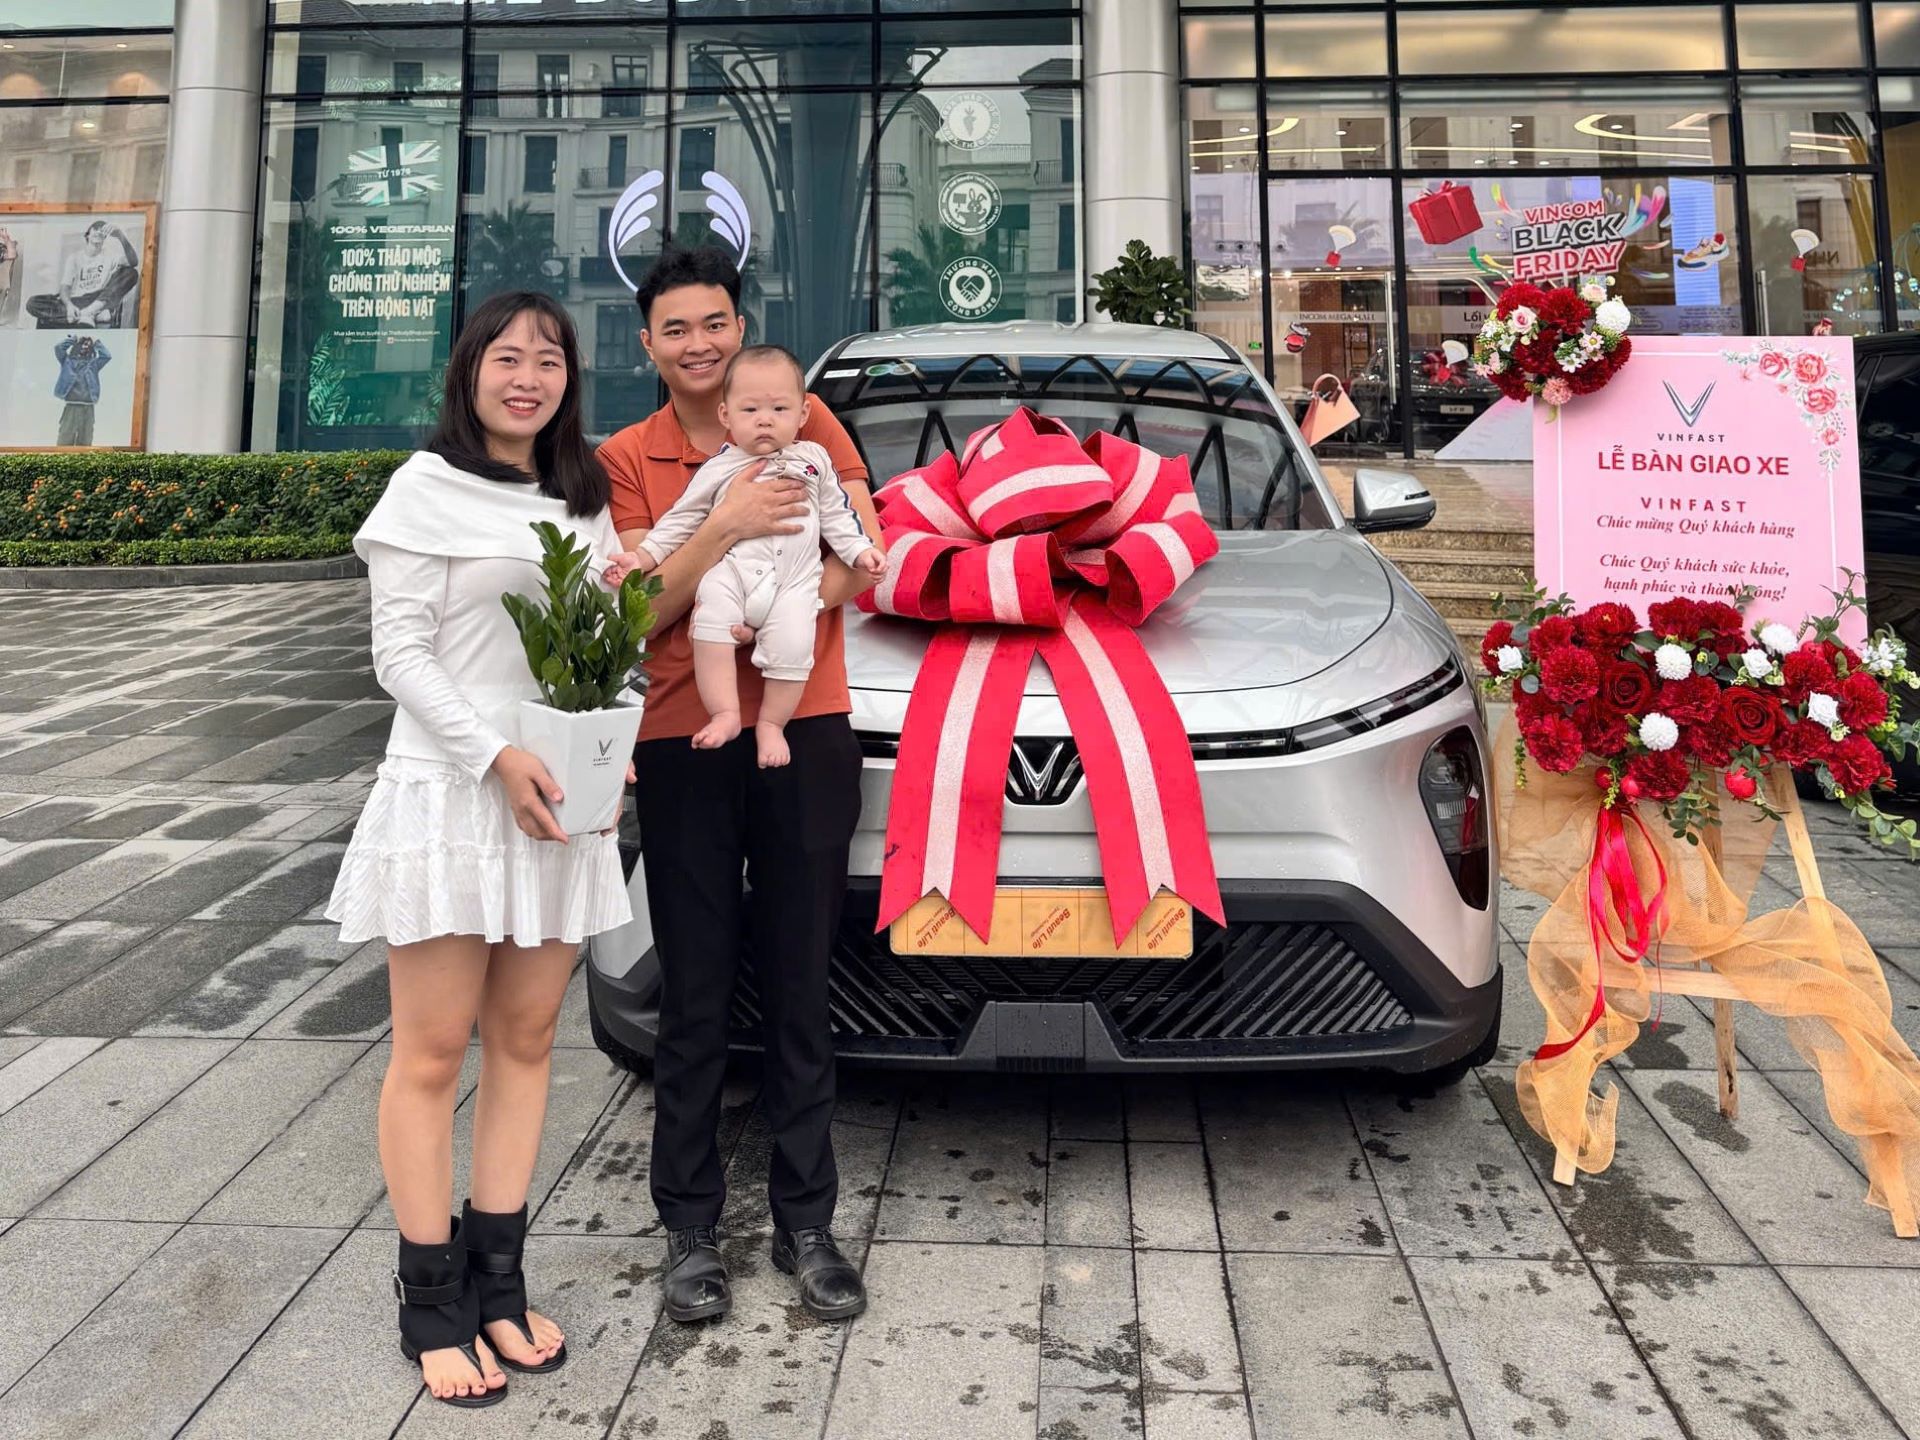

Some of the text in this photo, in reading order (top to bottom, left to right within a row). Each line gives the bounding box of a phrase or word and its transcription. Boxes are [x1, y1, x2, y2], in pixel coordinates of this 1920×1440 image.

[1524, 199, 1604, 224] VINCOM
[330, 224, 455, 234] 100% VEGETARIAN
[1513, 213, 1624, 251] BLACK
[341, 244, 441, 269] 100% THẢO MỘC
[1514, 243, 1623, 277] FRIDAY
[328, 270, 451, 295] CHỐNG THỬ NGHIỆM
[341, 295, 436, 320] TRÊN ĐỘNG VẬT
[1463, 310, 1481, 322] Lối
[1657, 433, 1725, 443] VINFAST
[1598, 445, 1789, 476] LỄ BÀN GIAO XE
[1641, 497, 1747, 513] VINFAST
[1597, 515, 1795, 539] Chúc mừng Quý khách hàng
[1599, 553, 1635, 569] Chúc
[1640, 555, 1670, 573] Quý
[1674, 557, 1717, 573] khách
[1721, 560, 1746, 574] sức
[1604, 577, 1638, 594] hạnh
[1642, 579, 1676, 595] phúc
[1680, 581, 1696, 594] và
[1744, 585, 1787, 601] ông!
[1046, 908, 1071, 937] Beauti
[1161, 908, 1186, 937] Beauti
[917, 931, 932, 948] Life
[1032, 932, 1048, 949] Life
[1147, 932, 1163, 950] Life
